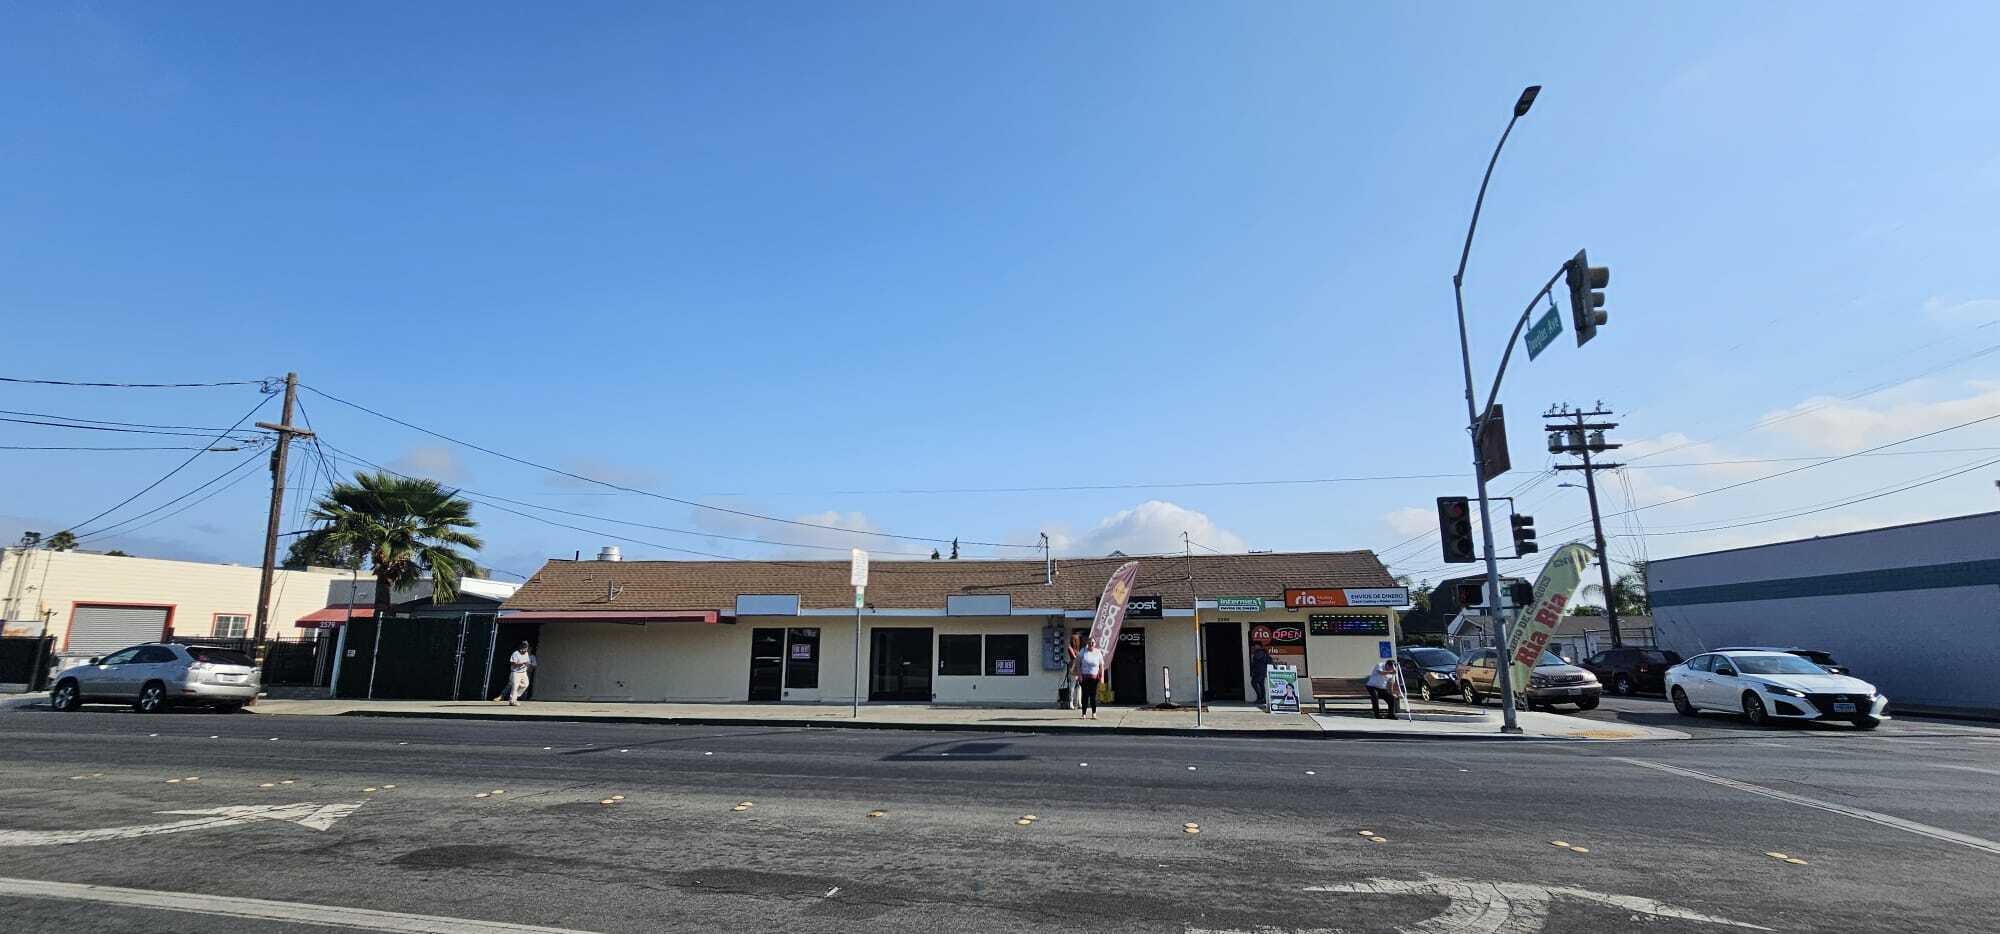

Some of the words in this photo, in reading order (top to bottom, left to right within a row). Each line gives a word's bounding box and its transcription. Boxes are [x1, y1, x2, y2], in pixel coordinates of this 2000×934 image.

[1547, 316, 1560, 335] Ave
[1127, 600, 1157, 610] oost
[1295, 591, 1317, 605] ria
[1100, 605, 1120, 656] boost
[1254, 628, 1270, 639] ria
[1272, 629, 1302, 640] OPEN
[1515, 630, 1549, 668] Ria
[1535, 592, 1569, 629] Ria
